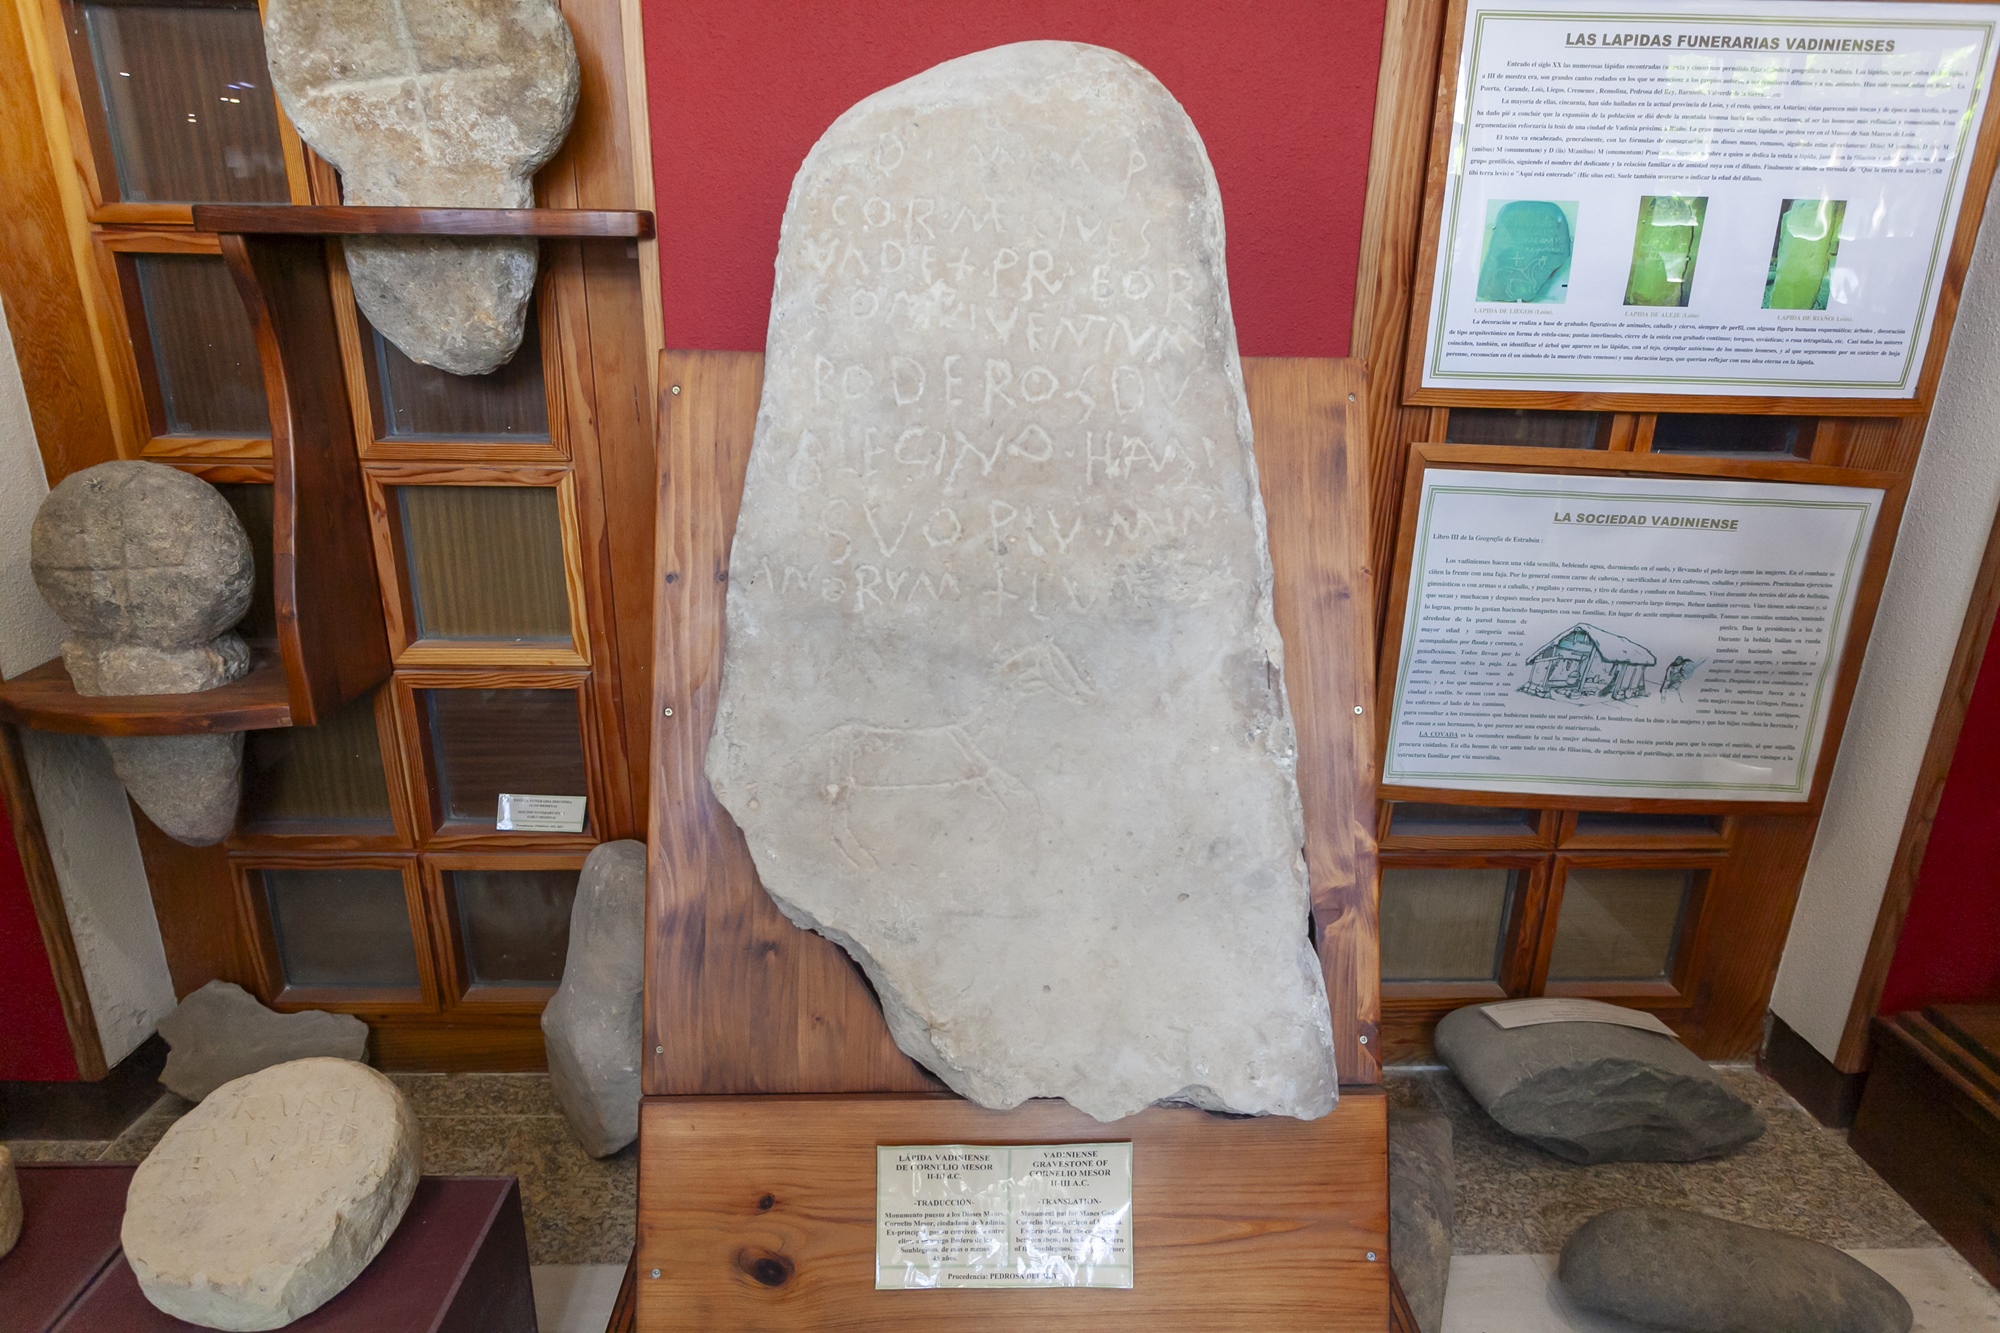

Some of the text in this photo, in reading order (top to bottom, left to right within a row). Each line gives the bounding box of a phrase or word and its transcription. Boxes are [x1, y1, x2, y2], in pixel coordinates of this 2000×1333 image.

[1565, 32, 1895, 52] LAS LAPIDAS FUNERARIAS VADINIENSES
[1553, 512, 1739, 529] LA SOCIEDAD VADINIENSE
[898, 1153, 932, 1161] LÁPIDA
[914, 1198, 974, 1206] -TRADUCCIÓN-
